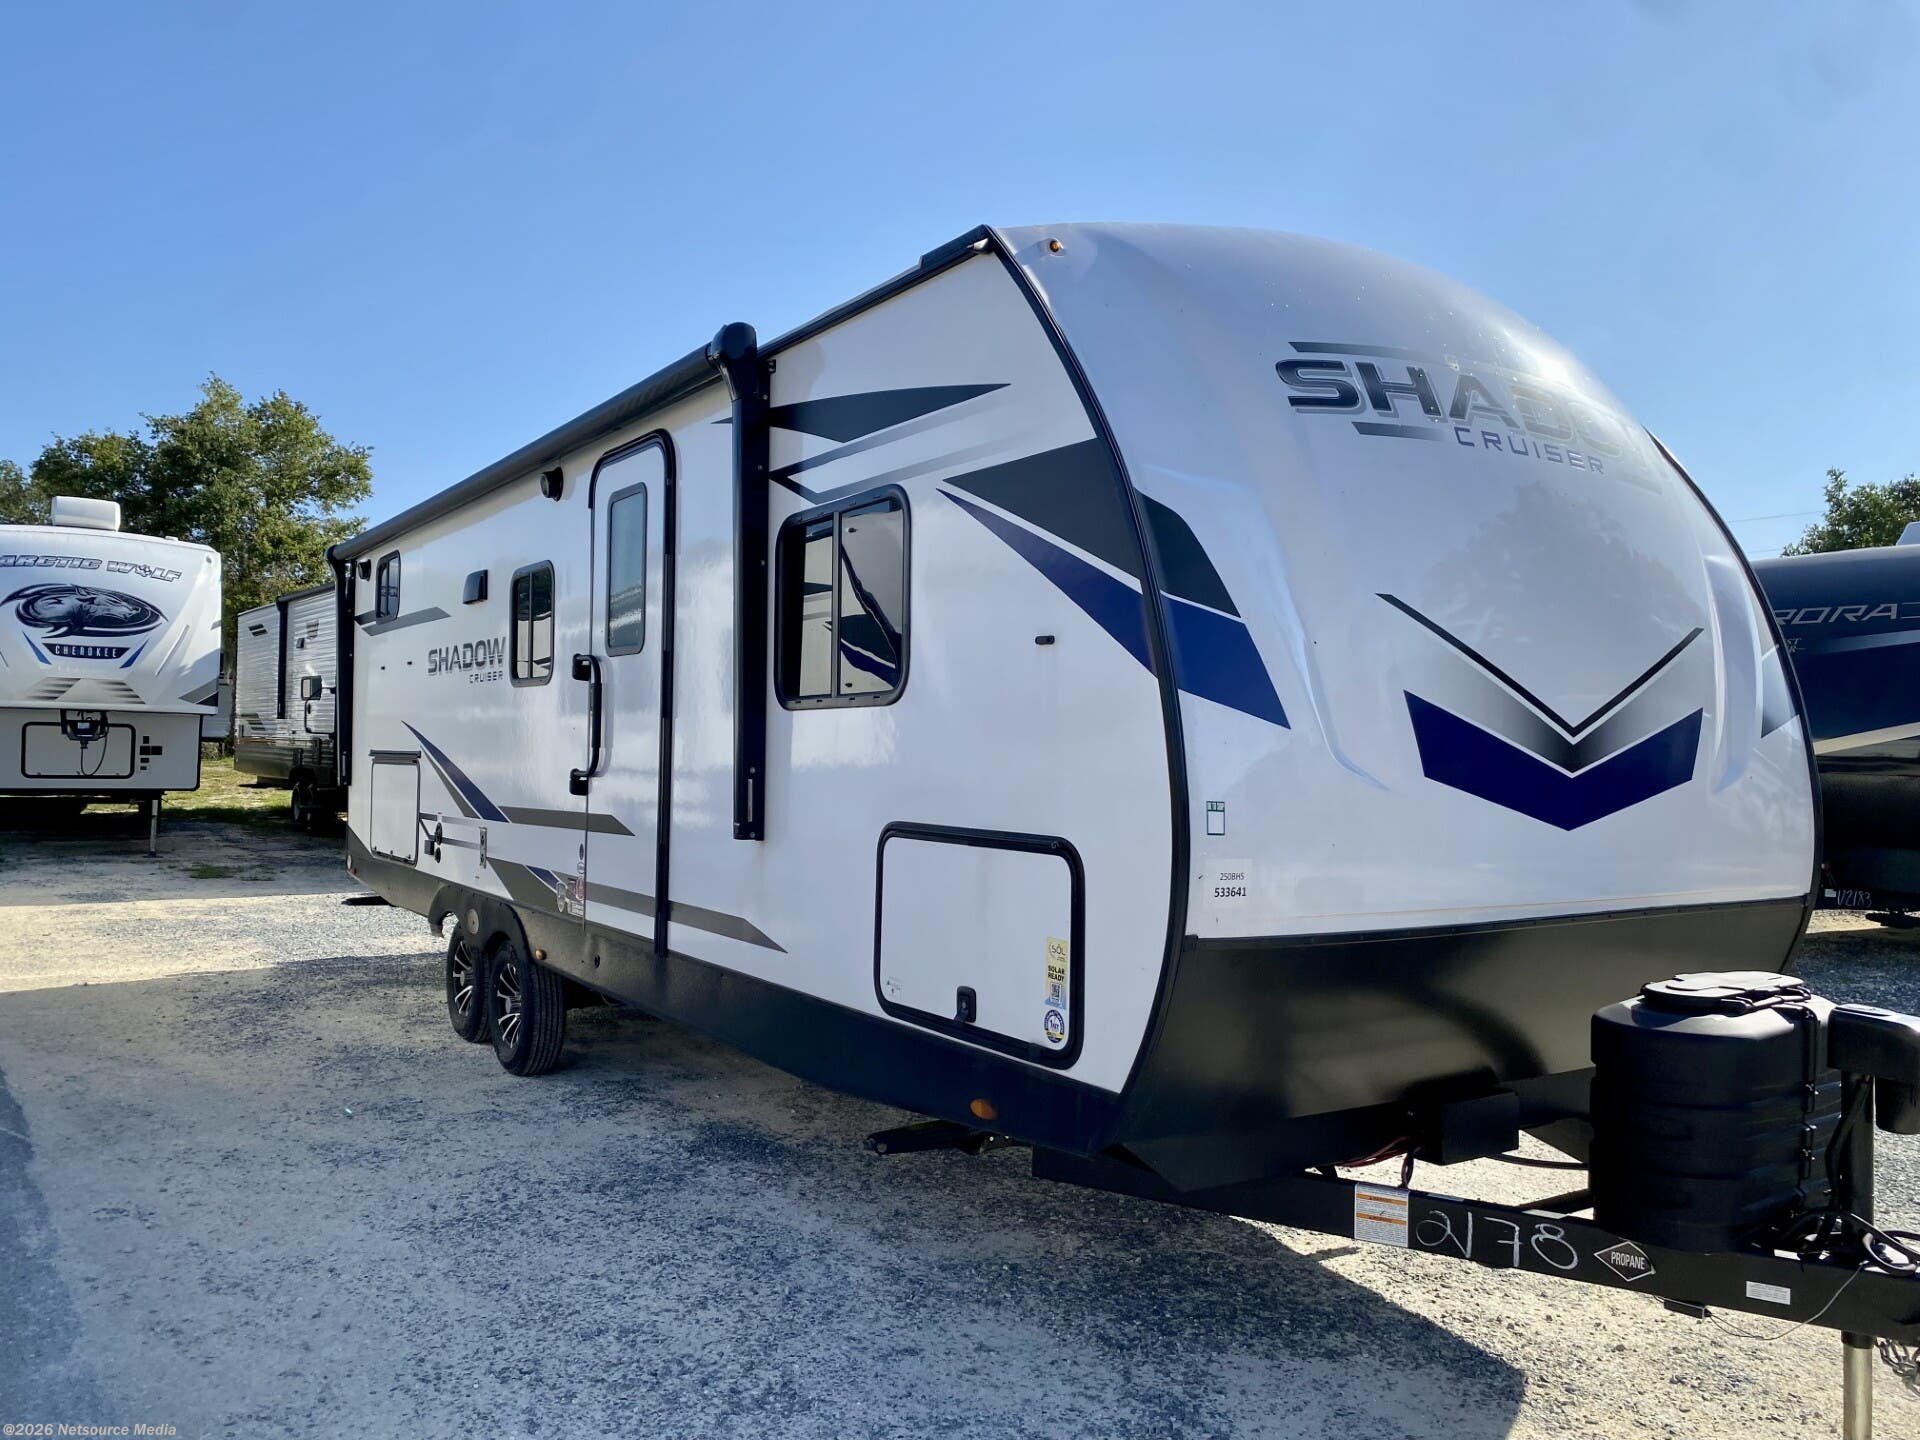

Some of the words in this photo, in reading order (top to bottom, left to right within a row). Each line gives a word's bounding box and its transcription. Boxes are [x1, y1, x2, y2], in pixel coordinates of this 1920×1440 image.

[1454, 426, 1604, 475] CRUISER
[0, 555, 102, 569] ARCTIC
[55, 645, 117, 657] CHEROKEE
[428, 636, 506, 674] SHADOW
[469, 670, 503, 684] CRUISER
[1214, 887, 1247, 898] 533641
[1048, 965, 1065, 975] SOLAR
[1048, 972, 1065, 982] READY
[1610, 1251, 1646, 1270] PROPANE
